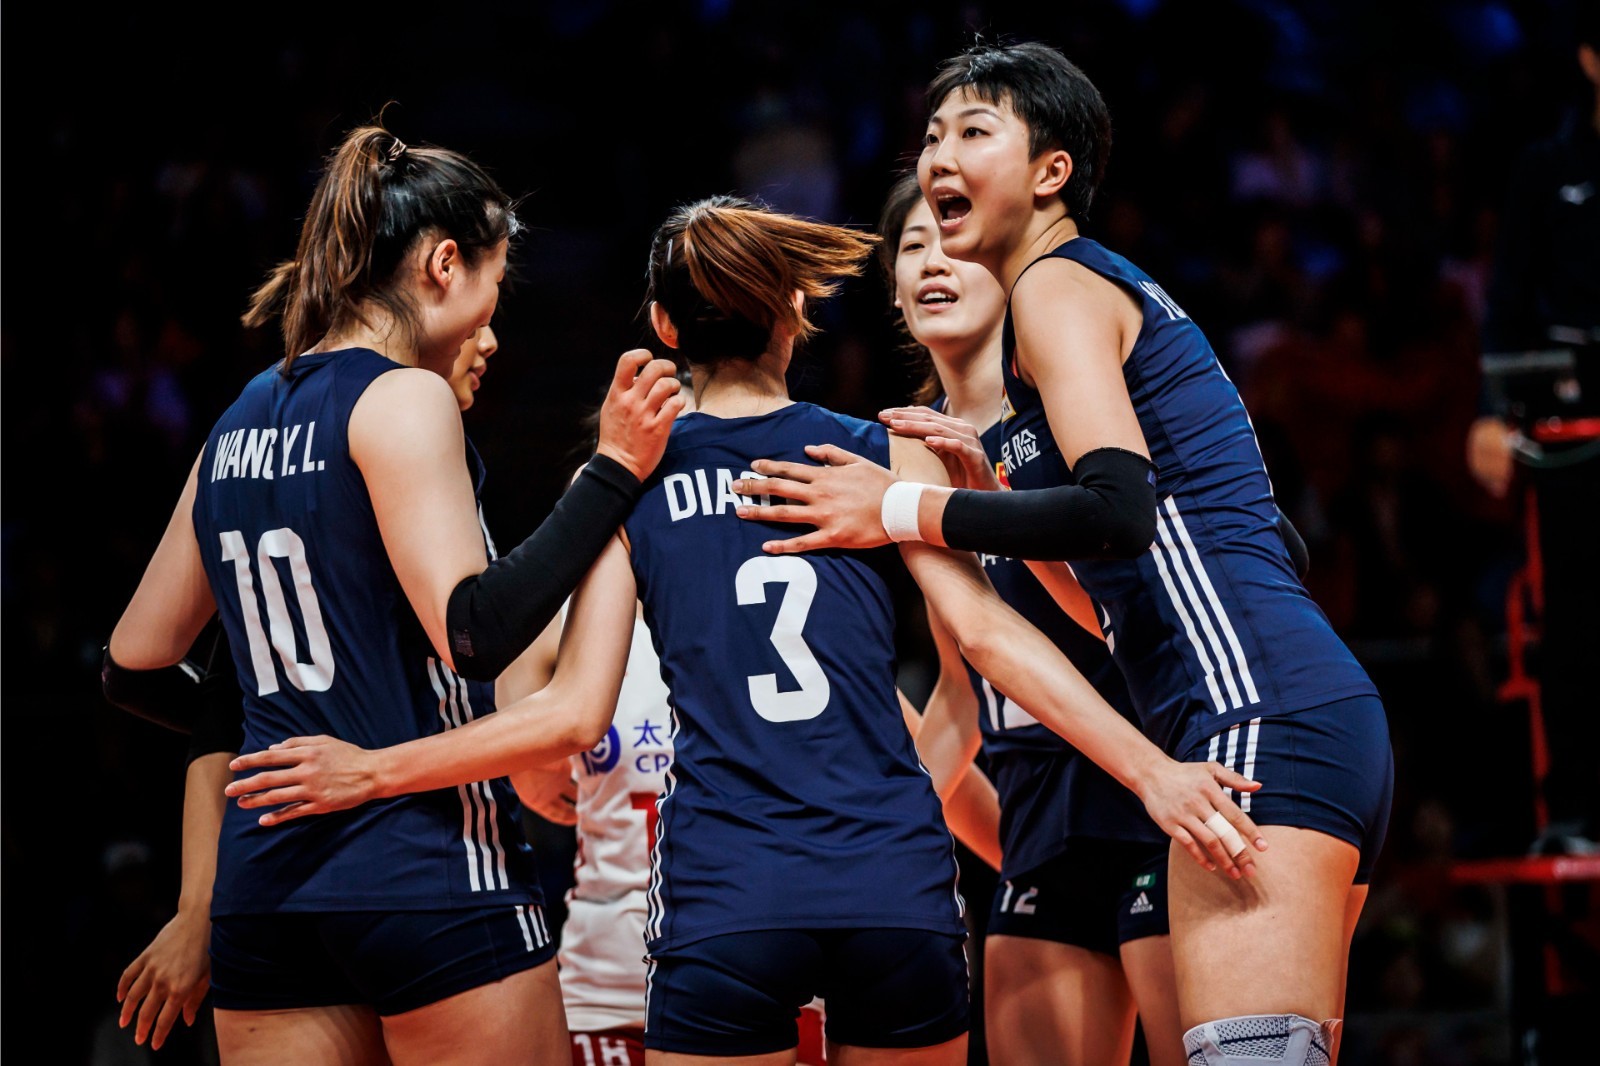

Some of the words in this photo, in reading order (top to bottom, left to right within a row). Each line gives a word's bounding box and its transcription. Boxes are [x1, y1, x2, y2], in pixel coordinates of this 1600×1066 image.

[219, 527, 335, 697] 10
[735, 555, 830, 723] 3
[633, 718, 671, 748] 太
[635, 753, 670, 773] CP
[1000, 880, 1039, 915] 12
